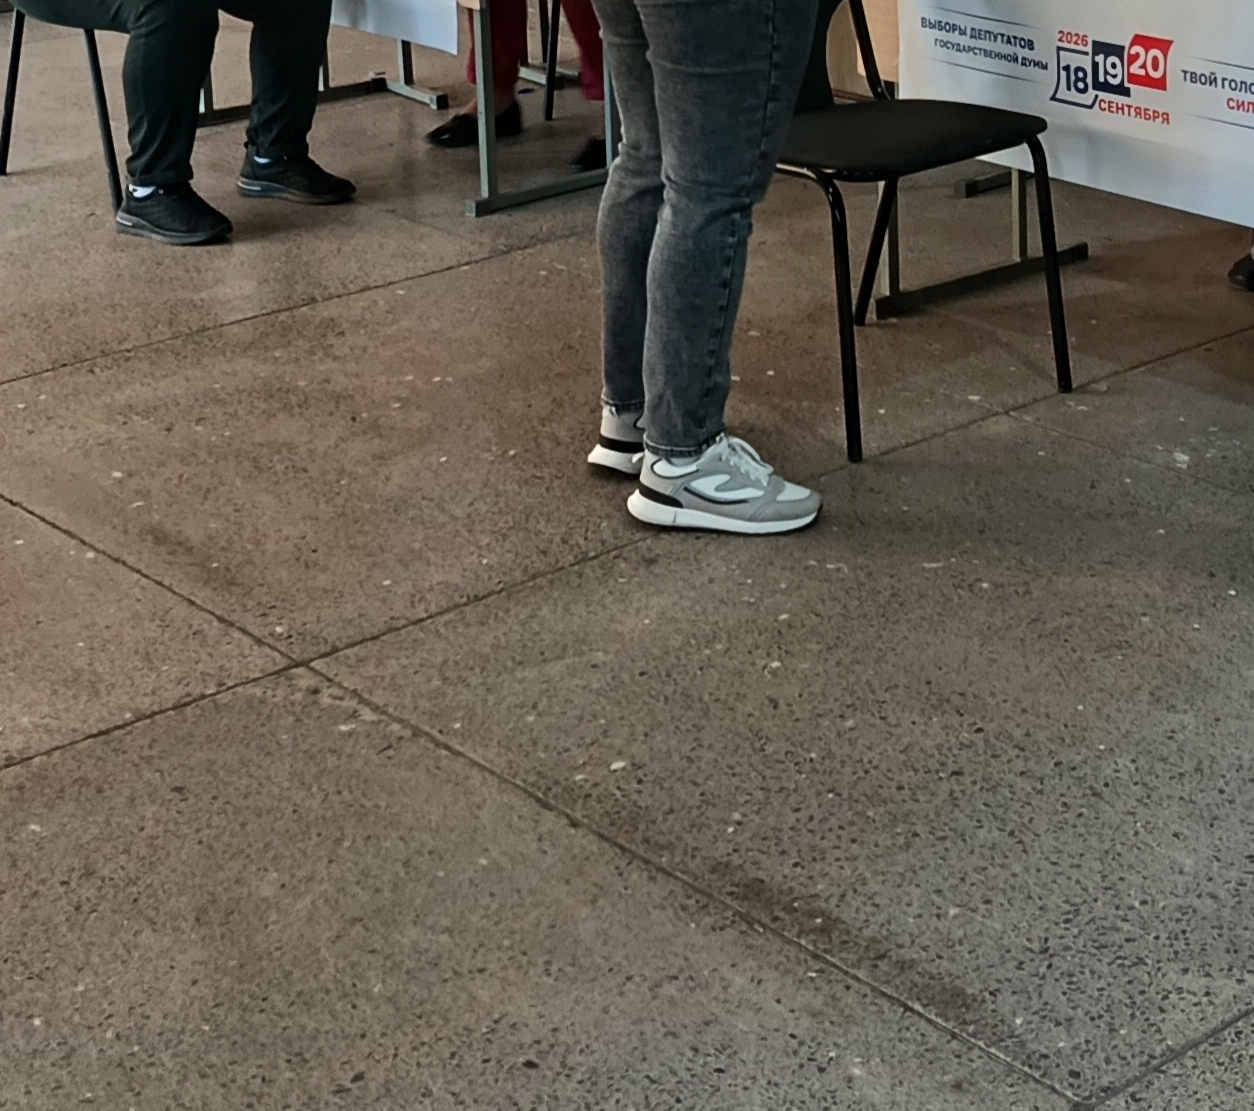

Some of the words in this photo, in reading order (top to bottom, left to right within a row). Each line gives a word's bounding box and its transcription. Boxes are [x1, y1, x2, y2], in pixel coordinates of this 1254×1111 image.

[921, 16, 968, 37] ВЫБОРЫ
[969, 27, 1035, 51] ДЕПУТАТОВ
[1057, 30, 1089, 47] 2026
[934, 37, 1019, 65] ГОСУДАРСТВЕННОЙ
[1020, 56, 1049, 71] ДУМЫ
[1062, 63, 1089, 95] 18
[1094, 53, 1123, 86] 19
[1129, 45, 1165, 79] 20
[1181, 69, 1218, 88] ТВОЙ
[1098, 98, 1170, 126] СЕНТЯБРЯ
